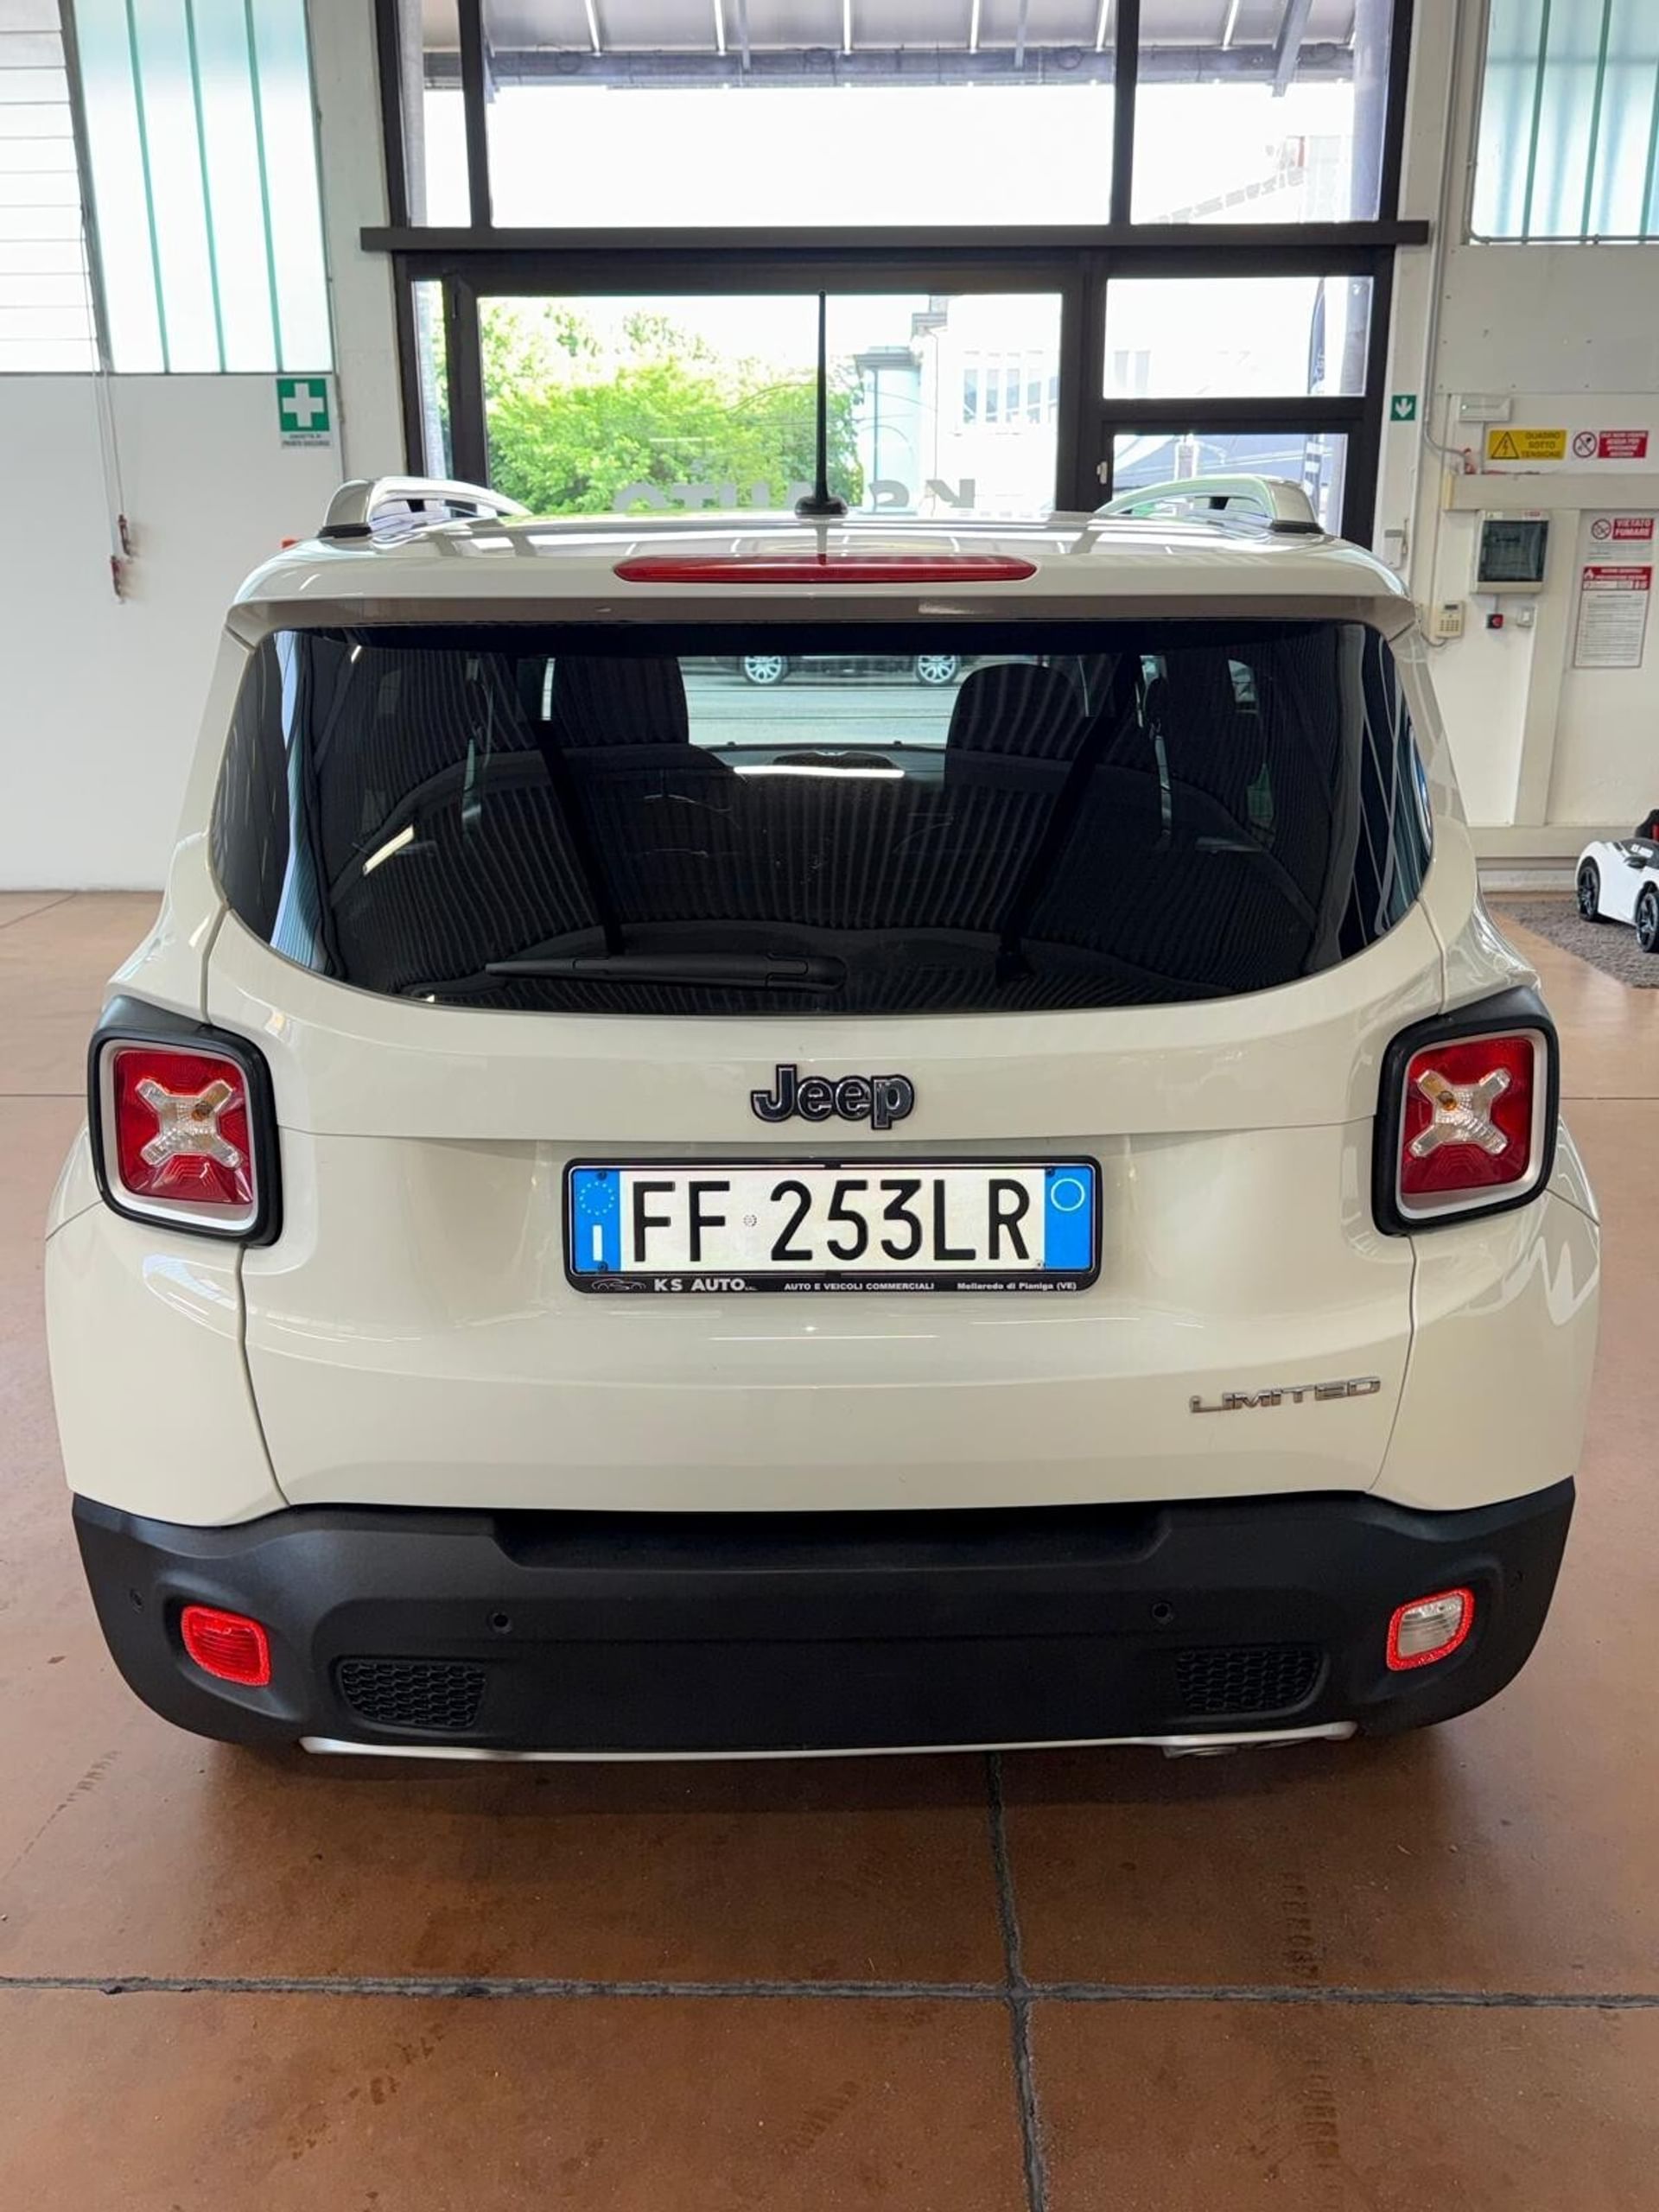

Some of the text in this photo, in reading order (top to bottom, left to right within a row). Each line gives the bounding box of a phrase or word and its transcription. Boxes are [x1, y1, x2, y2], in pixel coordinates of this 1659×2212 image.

[751, 1064, 914, 1129] Jeep
[632, 1179, 1031, 1262] FF 253LR
[654, 1278, 745, 1291] KS AUTO
[784, 1282, 811, 1291] AUTO
[1019, 1282, 1053, 1292] Pianiga
[1056, 1281, 1077, 1291] (VE)
[1189, 1376, 1381, 1413] LIMITED
